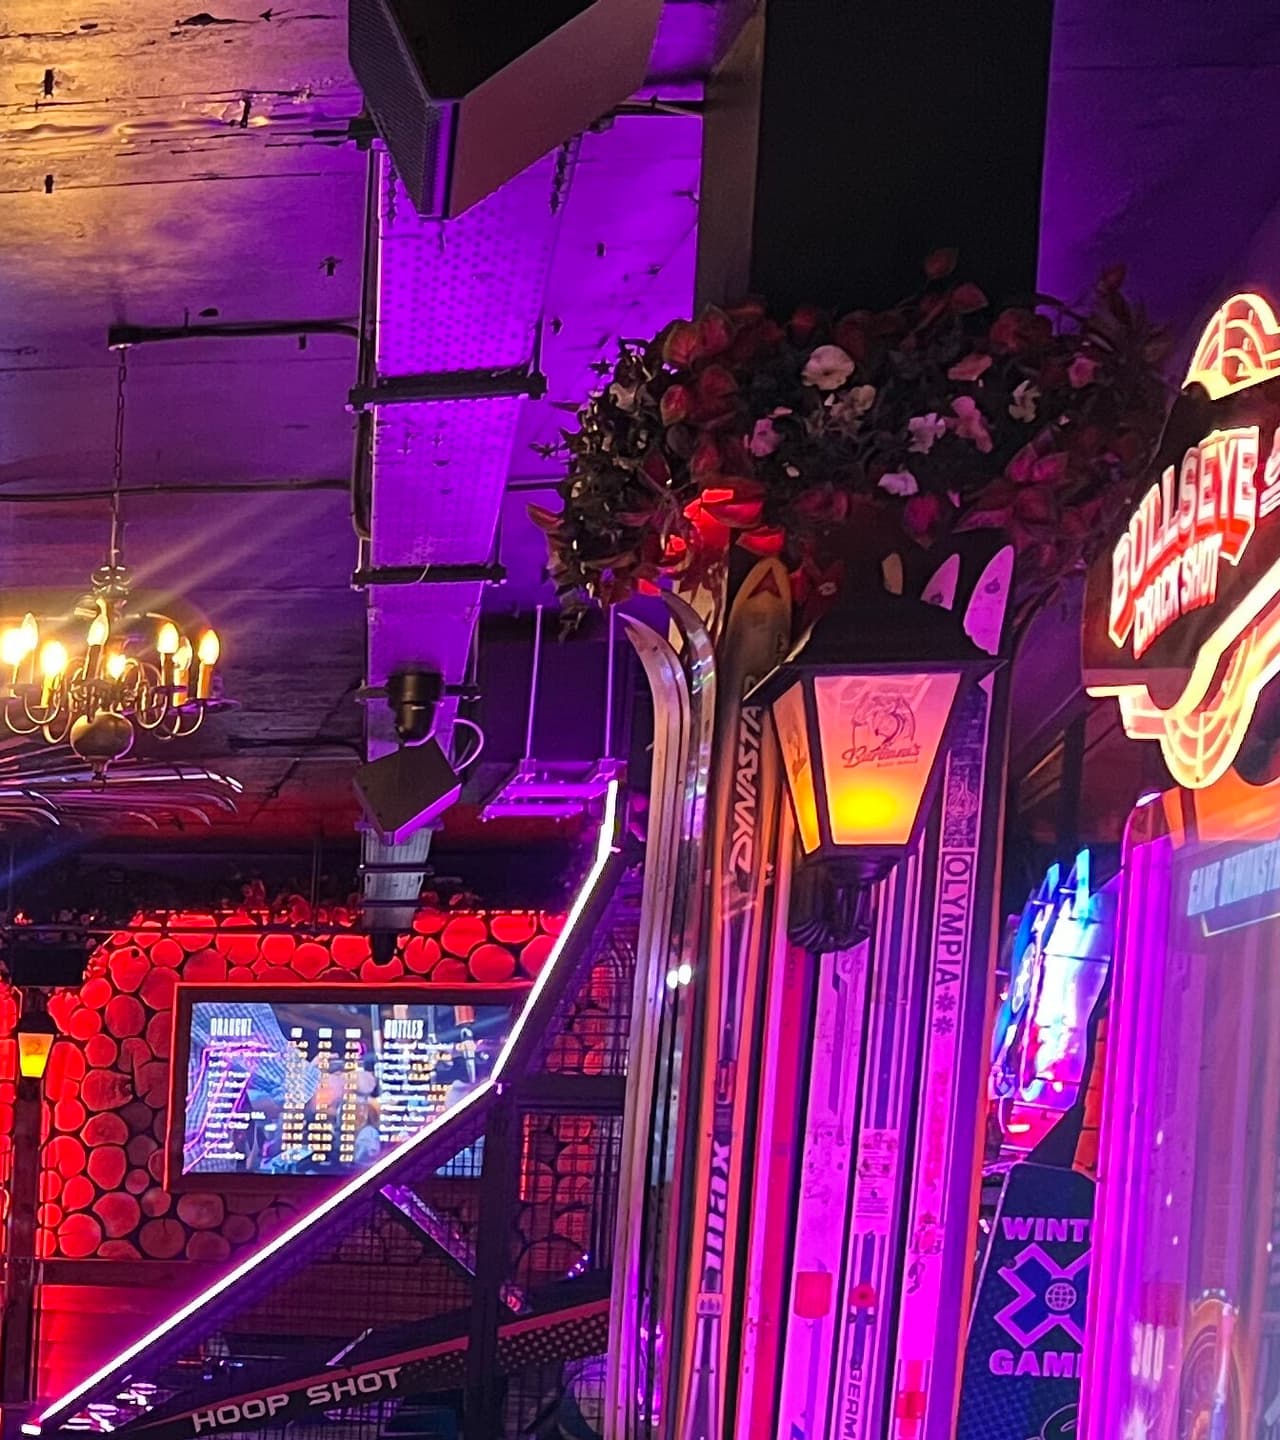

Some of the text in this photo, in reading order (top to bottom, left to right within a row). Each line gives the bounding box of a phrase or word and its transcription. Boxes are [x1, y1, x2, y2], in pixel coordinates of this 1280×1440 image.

[1111, 430, 1258, 615] BULLSEYE
[1134, 533, 1222, 652] CRACK SHOT
[729, 674, 762, 874] DYNASTA
[935, 856, 971, 987] OLYMPIA
[1002, 1216, 1089, 1242] WINT
[192, 1367, 401, 1433] HOOP SHOT
[989, 1348, 1081, 1378] GAM
